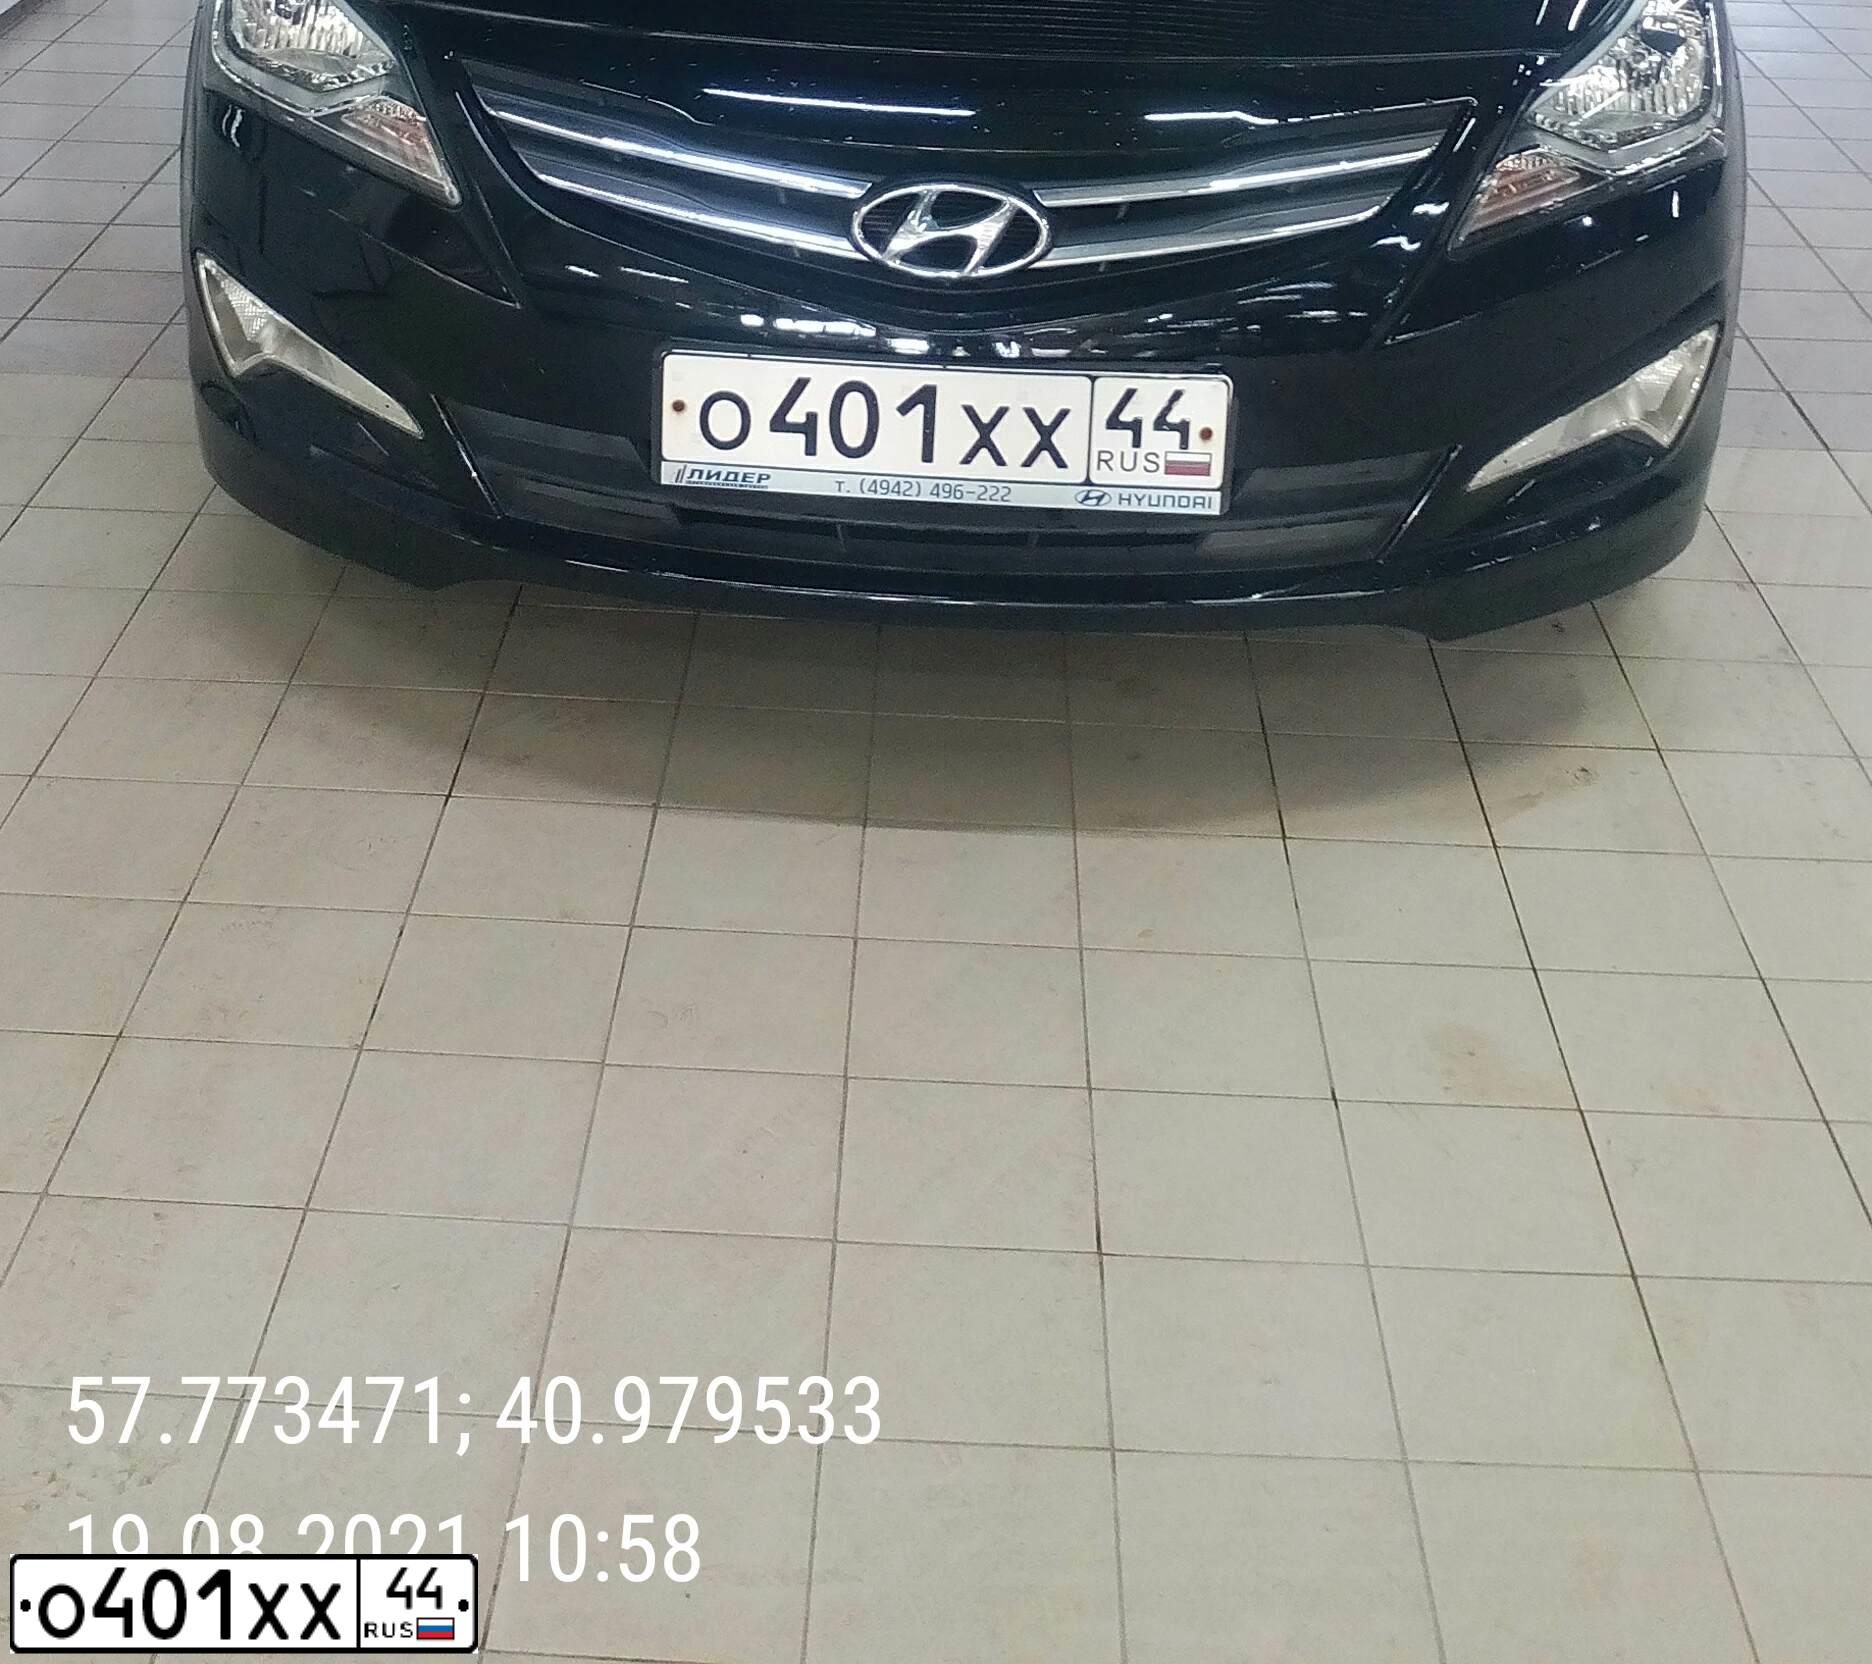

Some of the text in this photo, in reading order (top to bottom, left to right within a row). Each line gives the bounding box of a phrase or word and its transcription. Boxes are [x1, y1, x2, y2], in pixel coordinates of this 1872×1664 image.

[1105, 387, 1191, 451] 44
[1096, 450, 1161, 474] RUS
[687, 467, 772, 484] ЛИДЕР
[860, 477, 922, 498] (4942)
[929, 482, 1012, 503] 496-222
[1118, 492, 1213, 510] HYUNDAI
